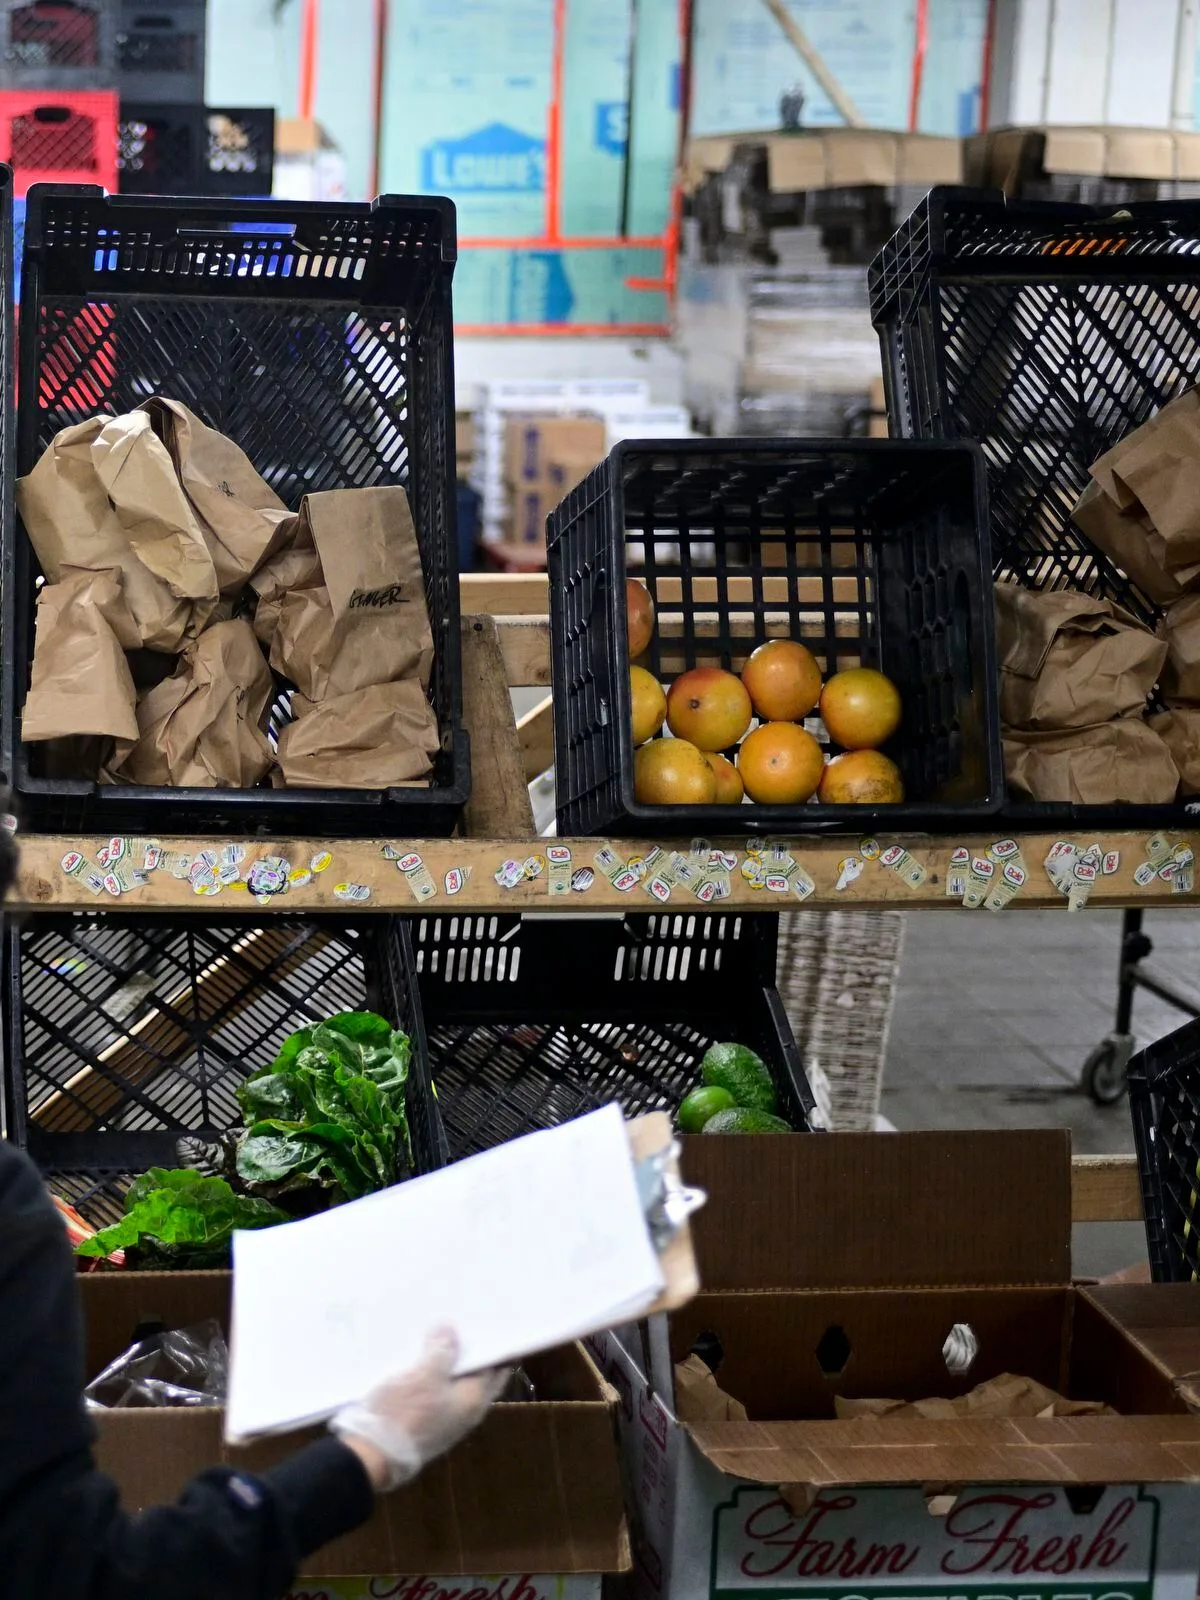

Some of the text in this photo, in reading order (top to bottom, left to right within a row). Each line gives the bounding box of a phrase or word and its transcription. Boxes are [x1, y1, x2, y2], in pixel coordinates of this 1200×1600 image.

[551, 850, 568, 858] Dole
[741, 1493, 1135, 1578] Farm Fresh
